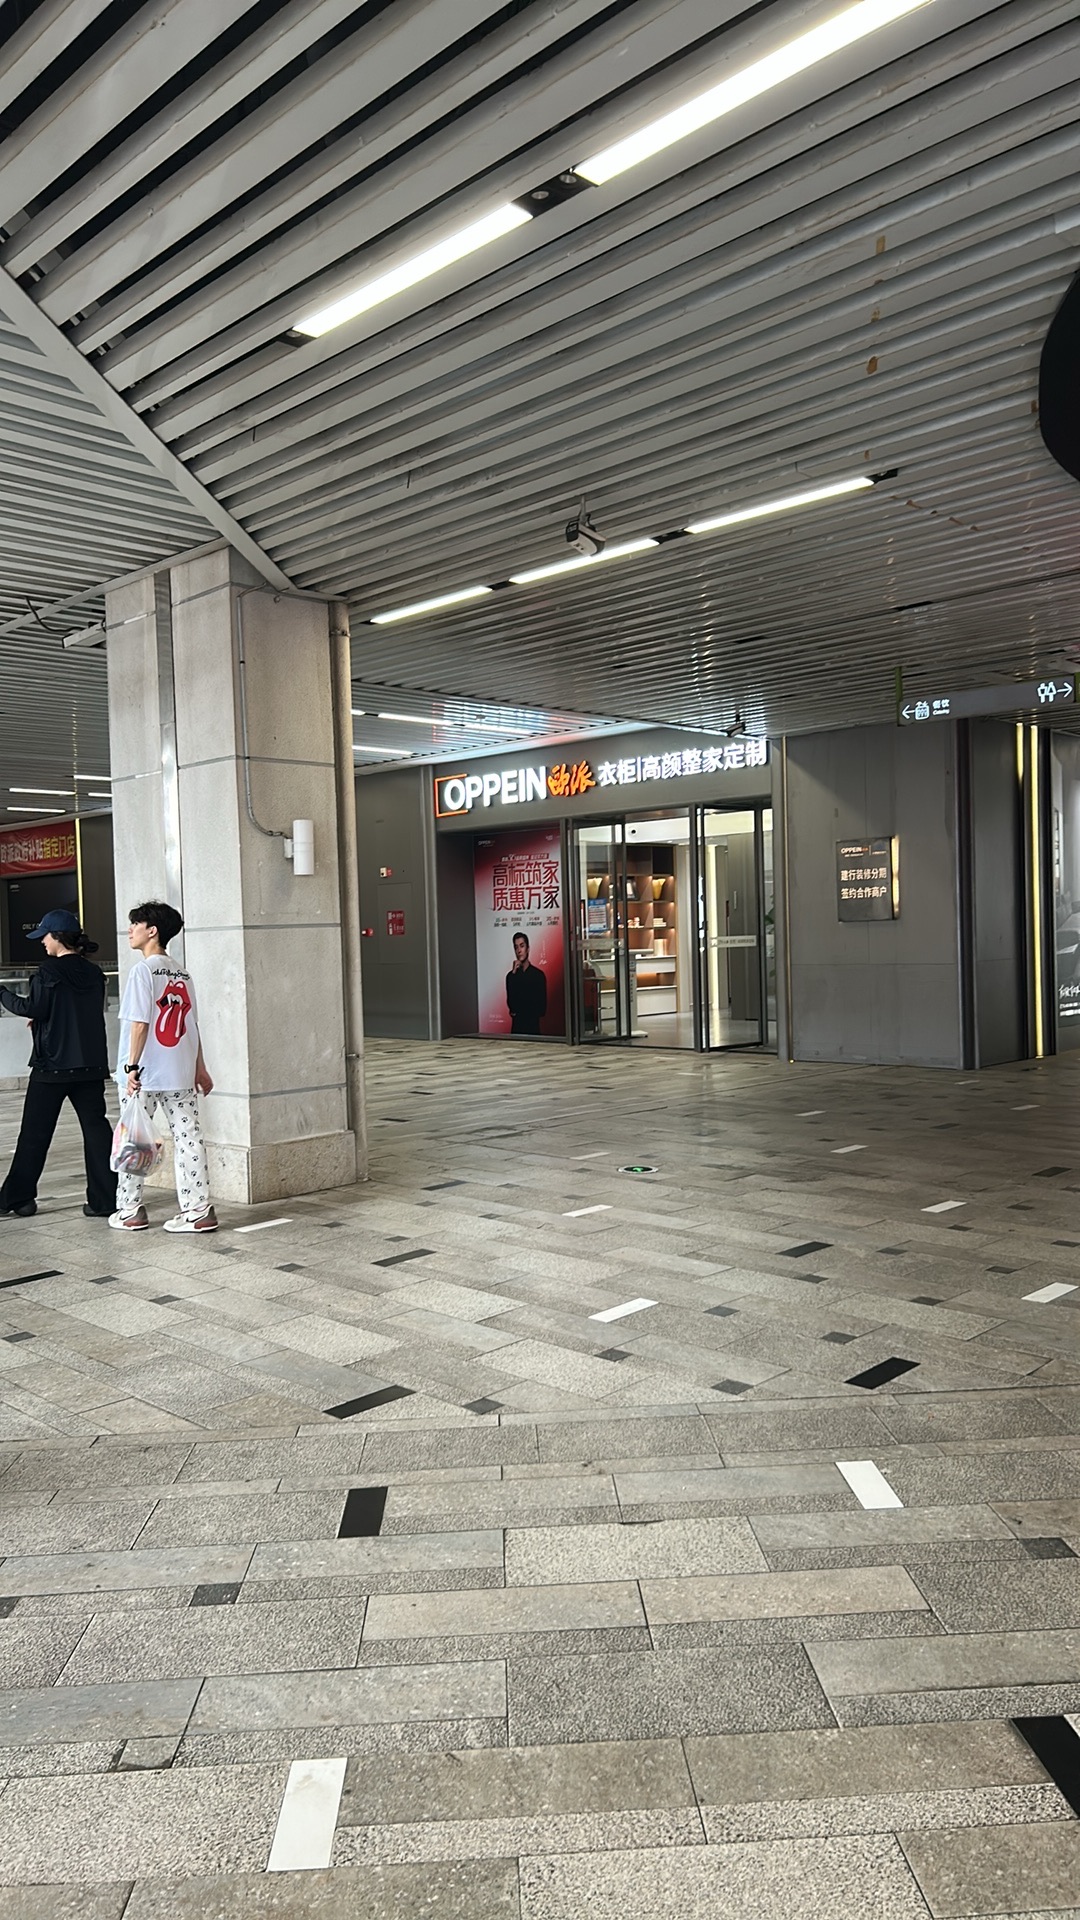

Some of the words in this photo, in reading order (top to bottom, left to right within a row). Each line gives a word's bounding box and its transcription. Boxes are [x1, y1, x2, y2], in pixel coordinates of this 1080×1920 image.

[444, 766, 547, 811] OPPEIN
[493, 860, 559, 887] 高标筑家
[840, 867, 887, 881] 建行装修分期
[492, 885, 560, 911] 质惠万家
[841, 886, 887, 899] 签约合作商户
